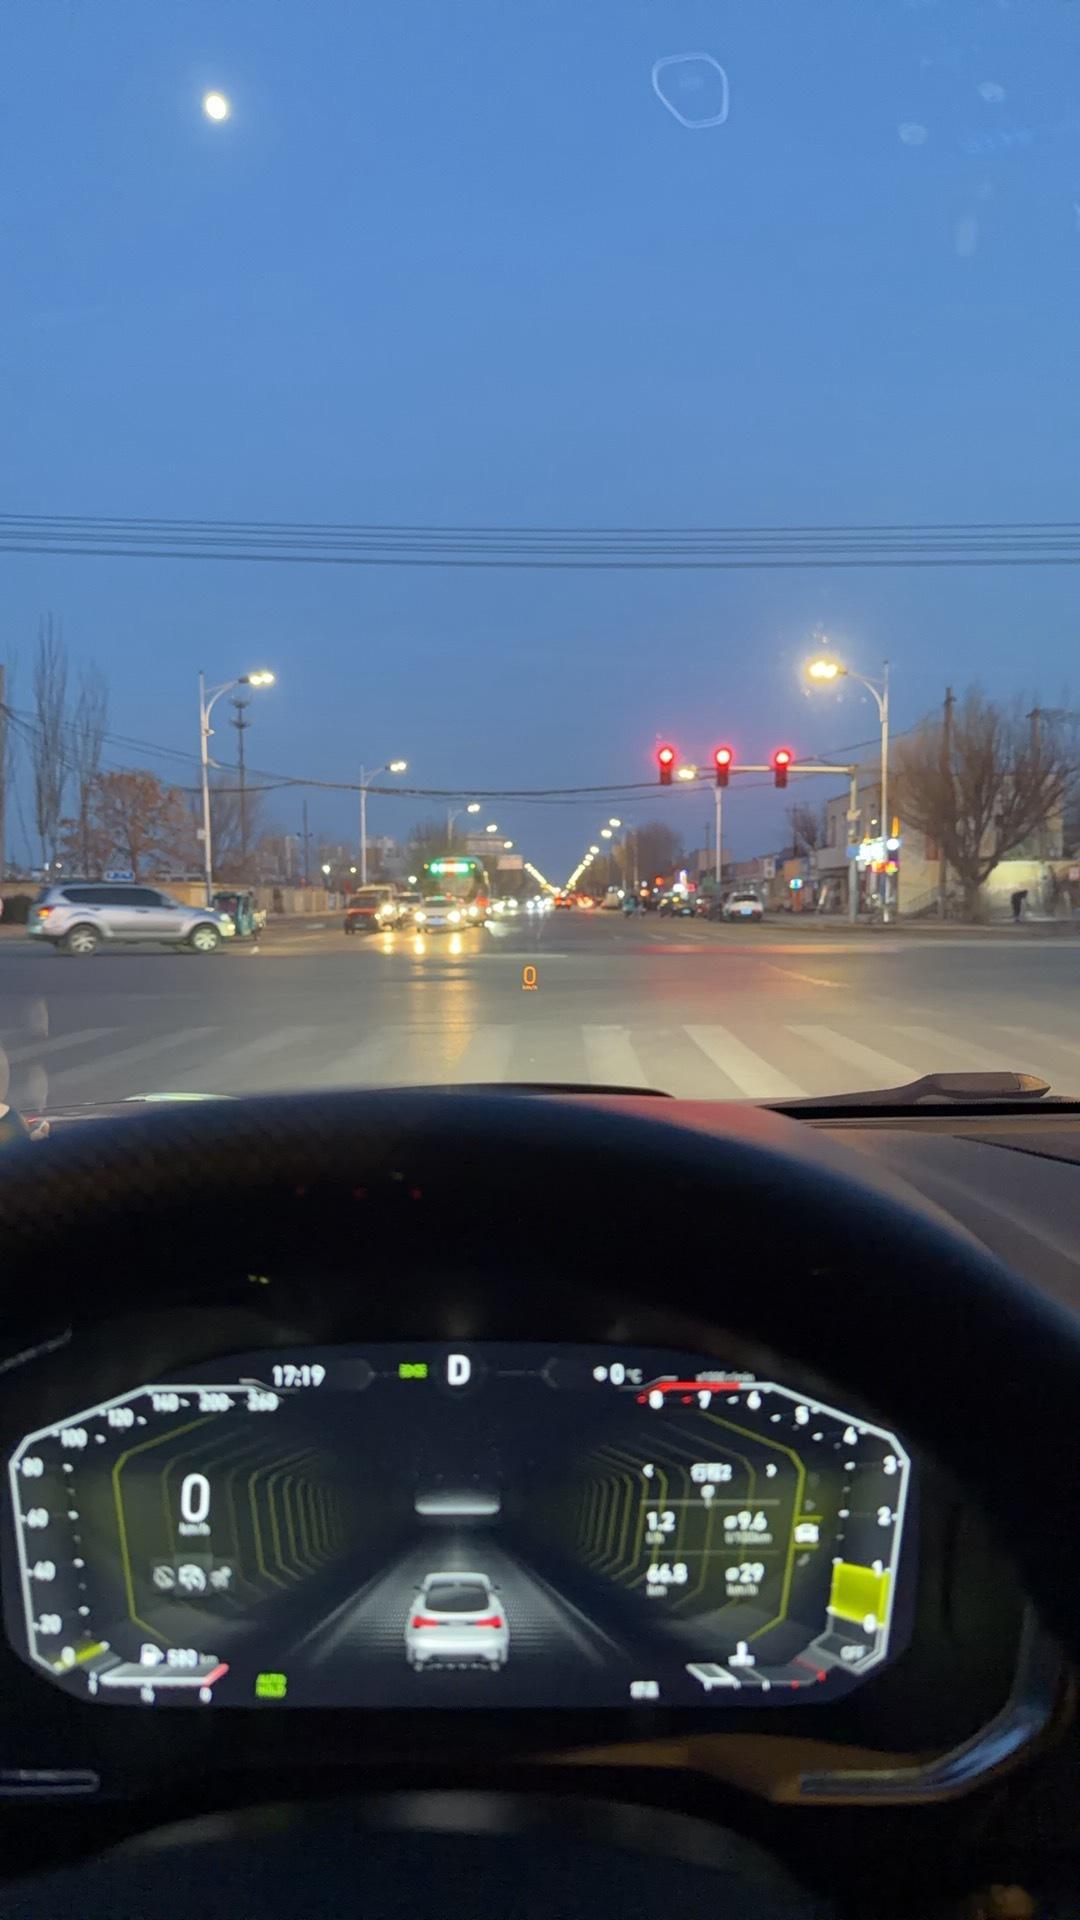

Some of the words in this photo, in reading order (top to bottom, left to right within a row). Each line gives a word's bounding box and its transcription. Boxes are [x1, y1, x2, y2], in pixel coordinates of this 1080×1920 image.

[273, 1365, 325, 1386] 17:19
[448, 1355, 470, 1385] D
[697, 1389, 712, 1409] 7
[884, 1456, 897, 1474] 3
[181, 1474, 209, 1522] 0
[647, 1512, 674, 1531] 1.2
[878, 1506, 892, 1526] 2
[647, 1563, 687, 1583] 66.8
